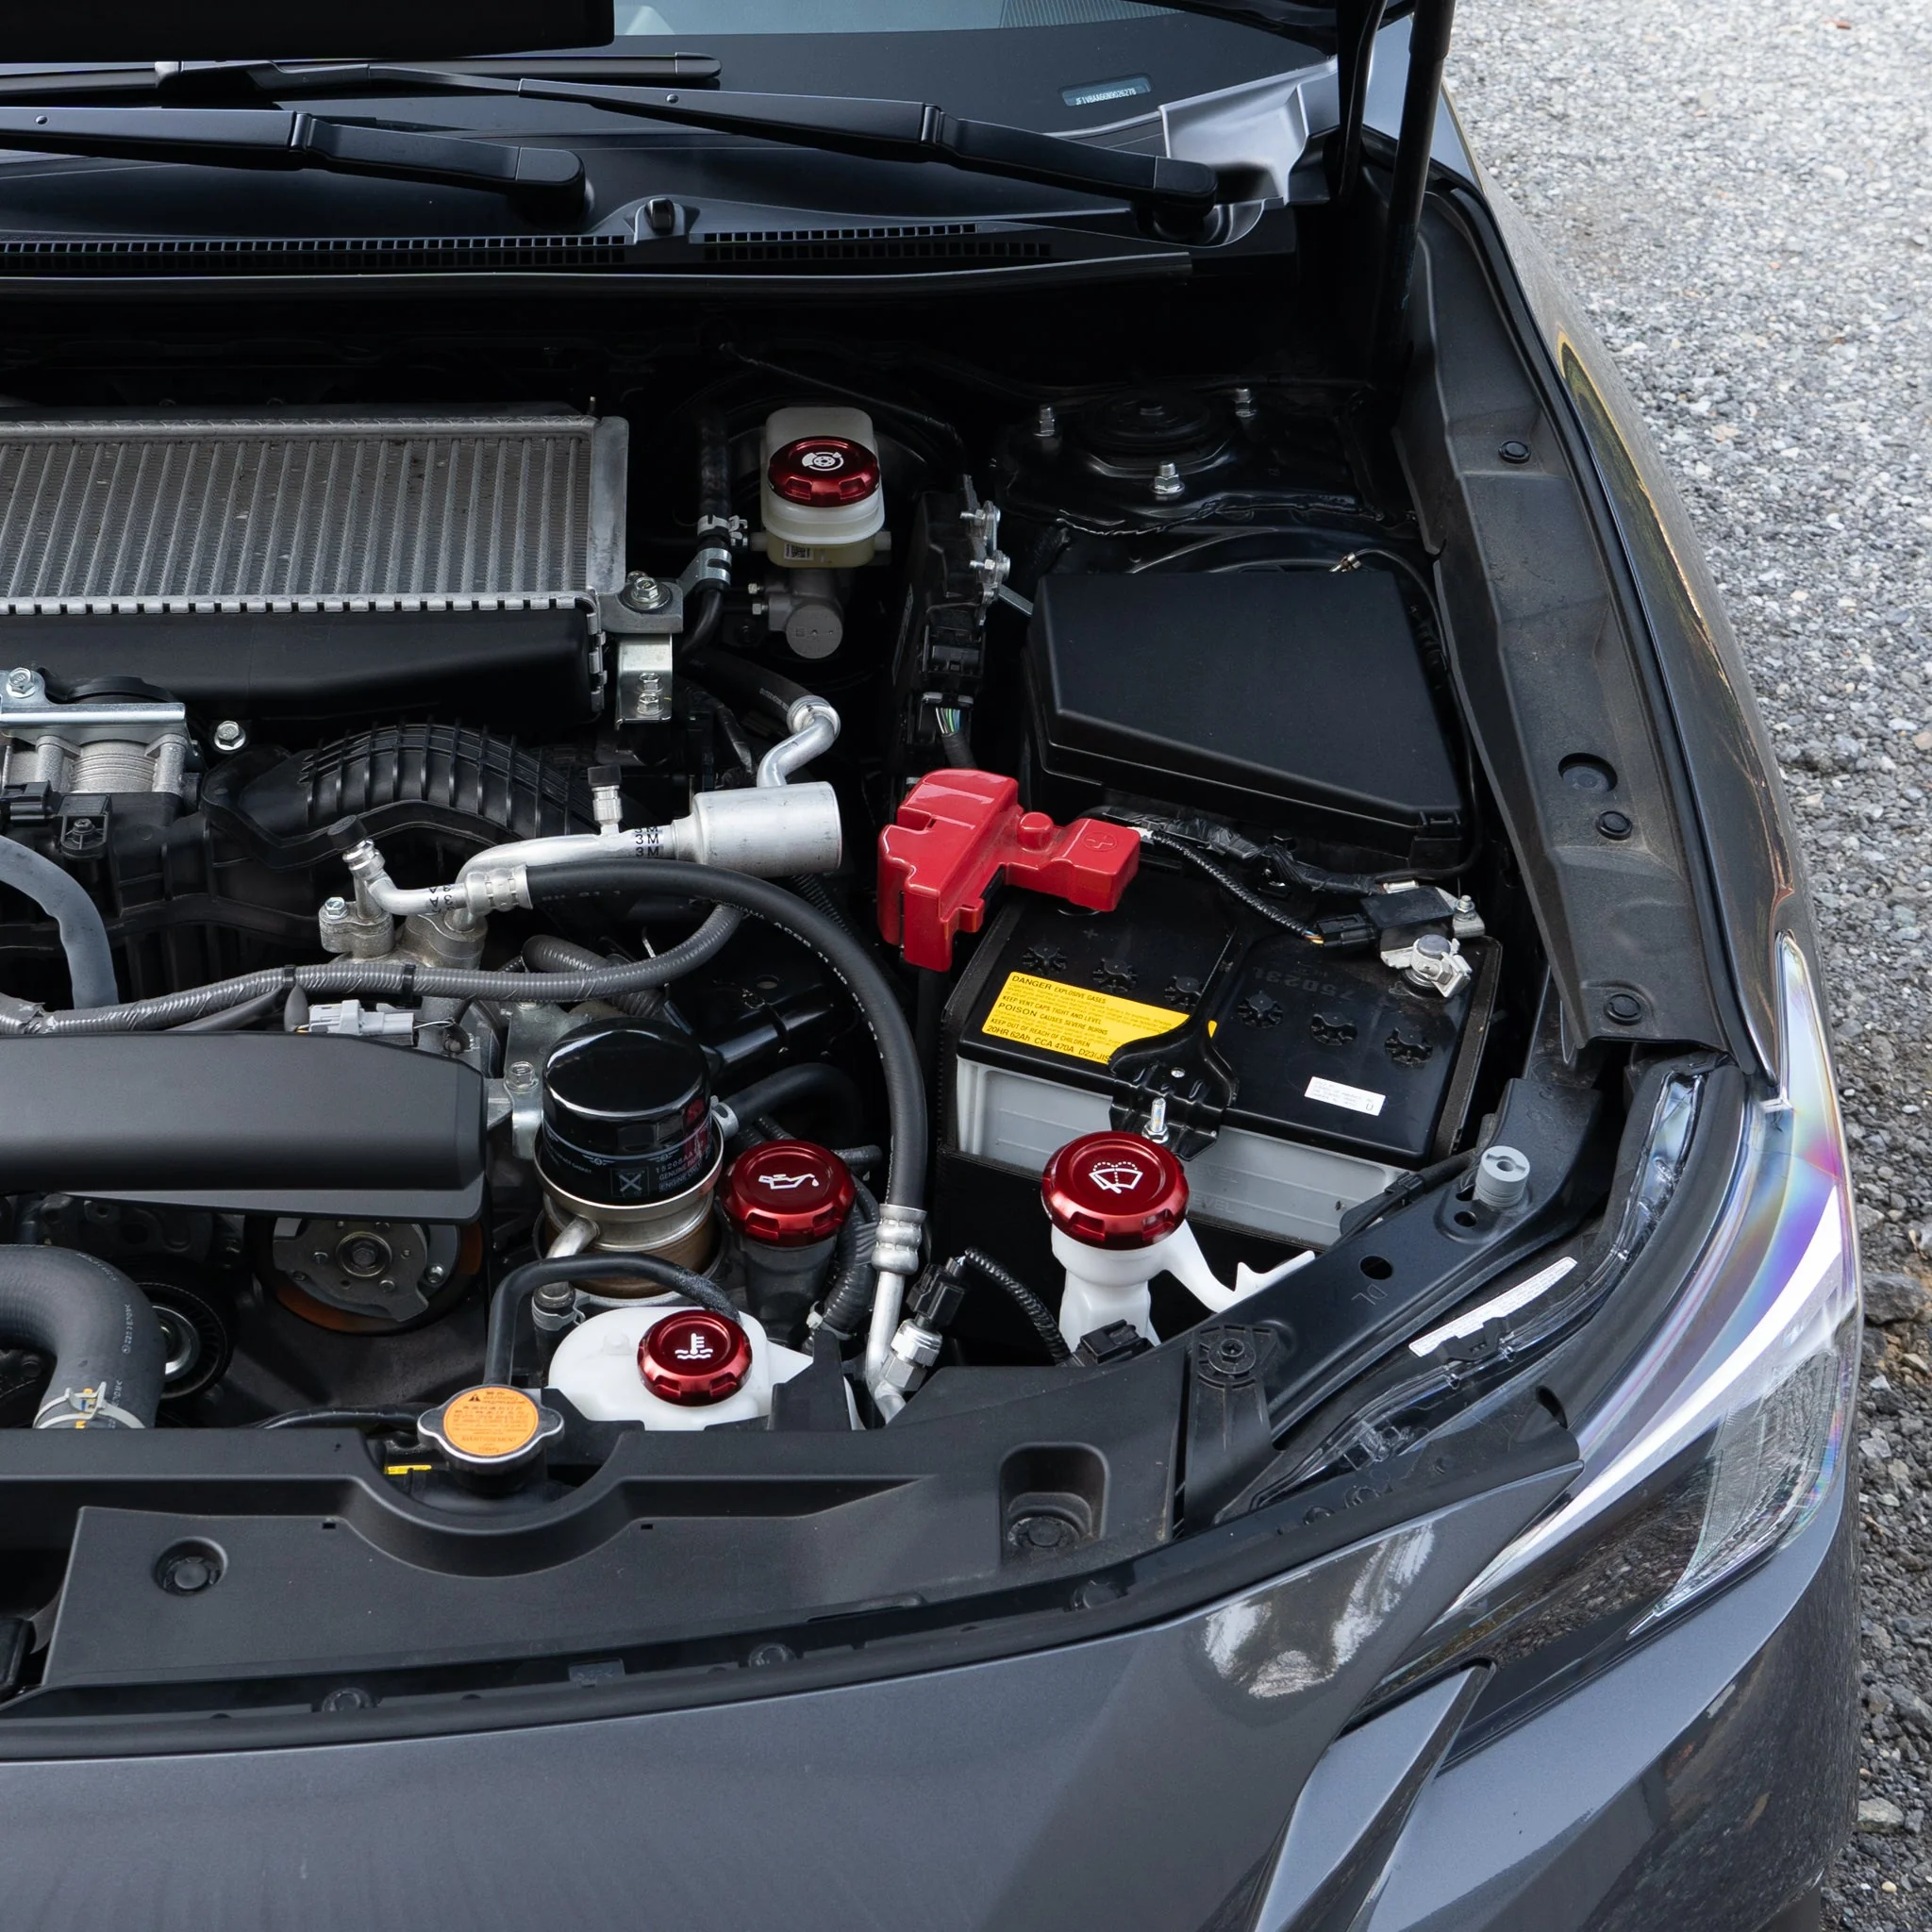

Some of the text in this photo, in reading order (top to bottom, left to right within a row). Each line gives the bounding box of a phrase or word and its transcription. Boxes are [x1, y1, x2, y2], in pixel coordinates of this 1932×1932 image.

[1011, 975, 1107, 1004] DANGER EXPLOSIVE GASES
[998, 1003, 1108, 1035] POISON CAUSES SEVERE BURNS
[1002, 995, 1018, 1004] KEEP
[1034, 1004, 1051, 1012] CAPS
[1052, 1008, 1069, 1017] TIGHT
[1084, 1016, 1102, 1024] LEVEL
[987, 1025, 1009, 1036] 20HR
[1009, 1032, 1032, 1041] 62Ah
[1034, 1038, 1054, 1047] CCA
[1055, 1043, 1075, 1053] 470A
[991, 1018, 1007, 1026] KEEP
[1007, 1022, 1019, 1030] OUT
[1029, 1028, 1050, 1038] REACH
[1059, 1036, 1090, 1048] CHILDREN
